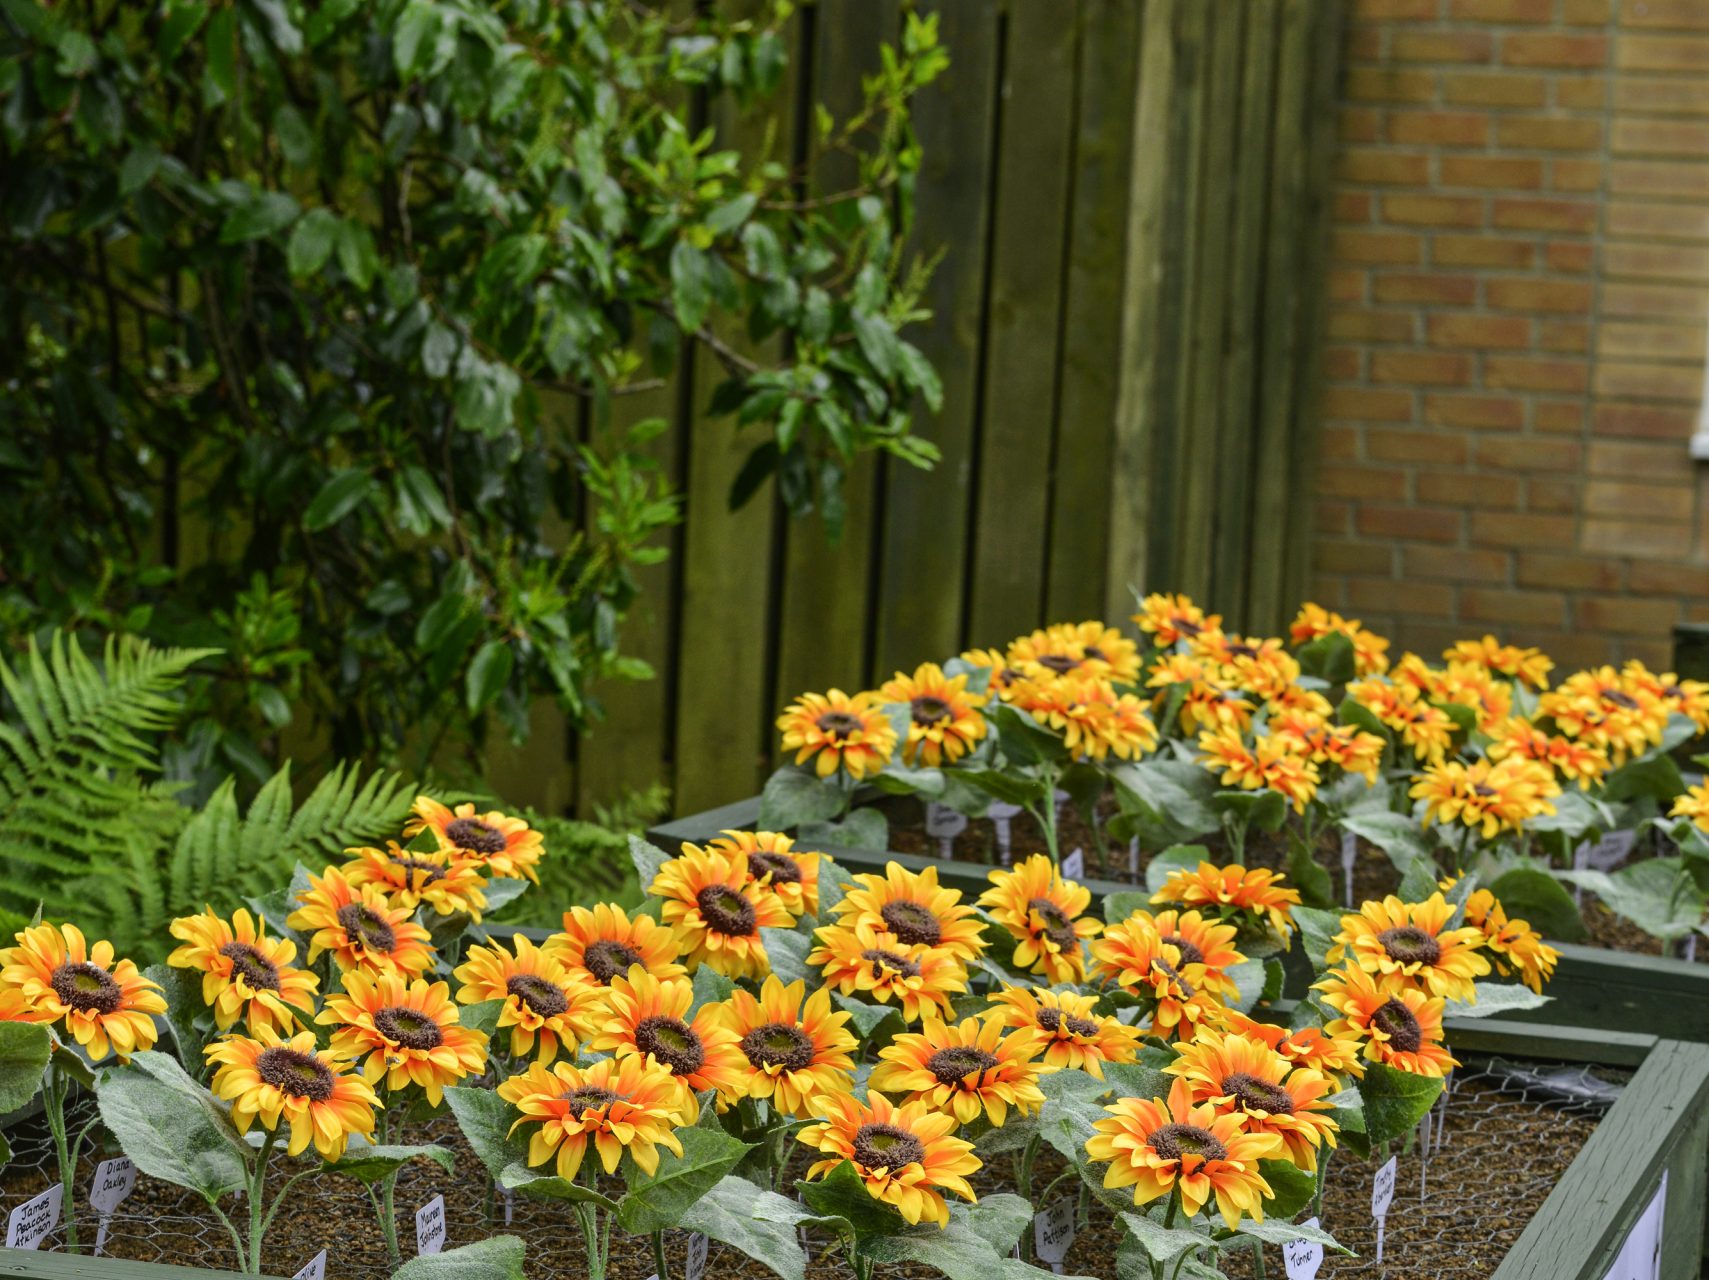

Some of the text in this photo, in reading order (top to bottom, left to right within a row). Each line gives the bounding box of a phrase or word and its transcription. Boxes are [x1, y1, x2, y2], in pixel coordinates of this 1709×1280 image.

[106, 1160, 130, 1175] Diana
[21, 1197, 50, 1220] James
[420, 1205, 441, 1228] Maureen
[13, 1220, 51, 1248] Atkinson
[16, 1209, 51, 1236] Peacock
[1290, 1250, 1313, 1268] Turner
